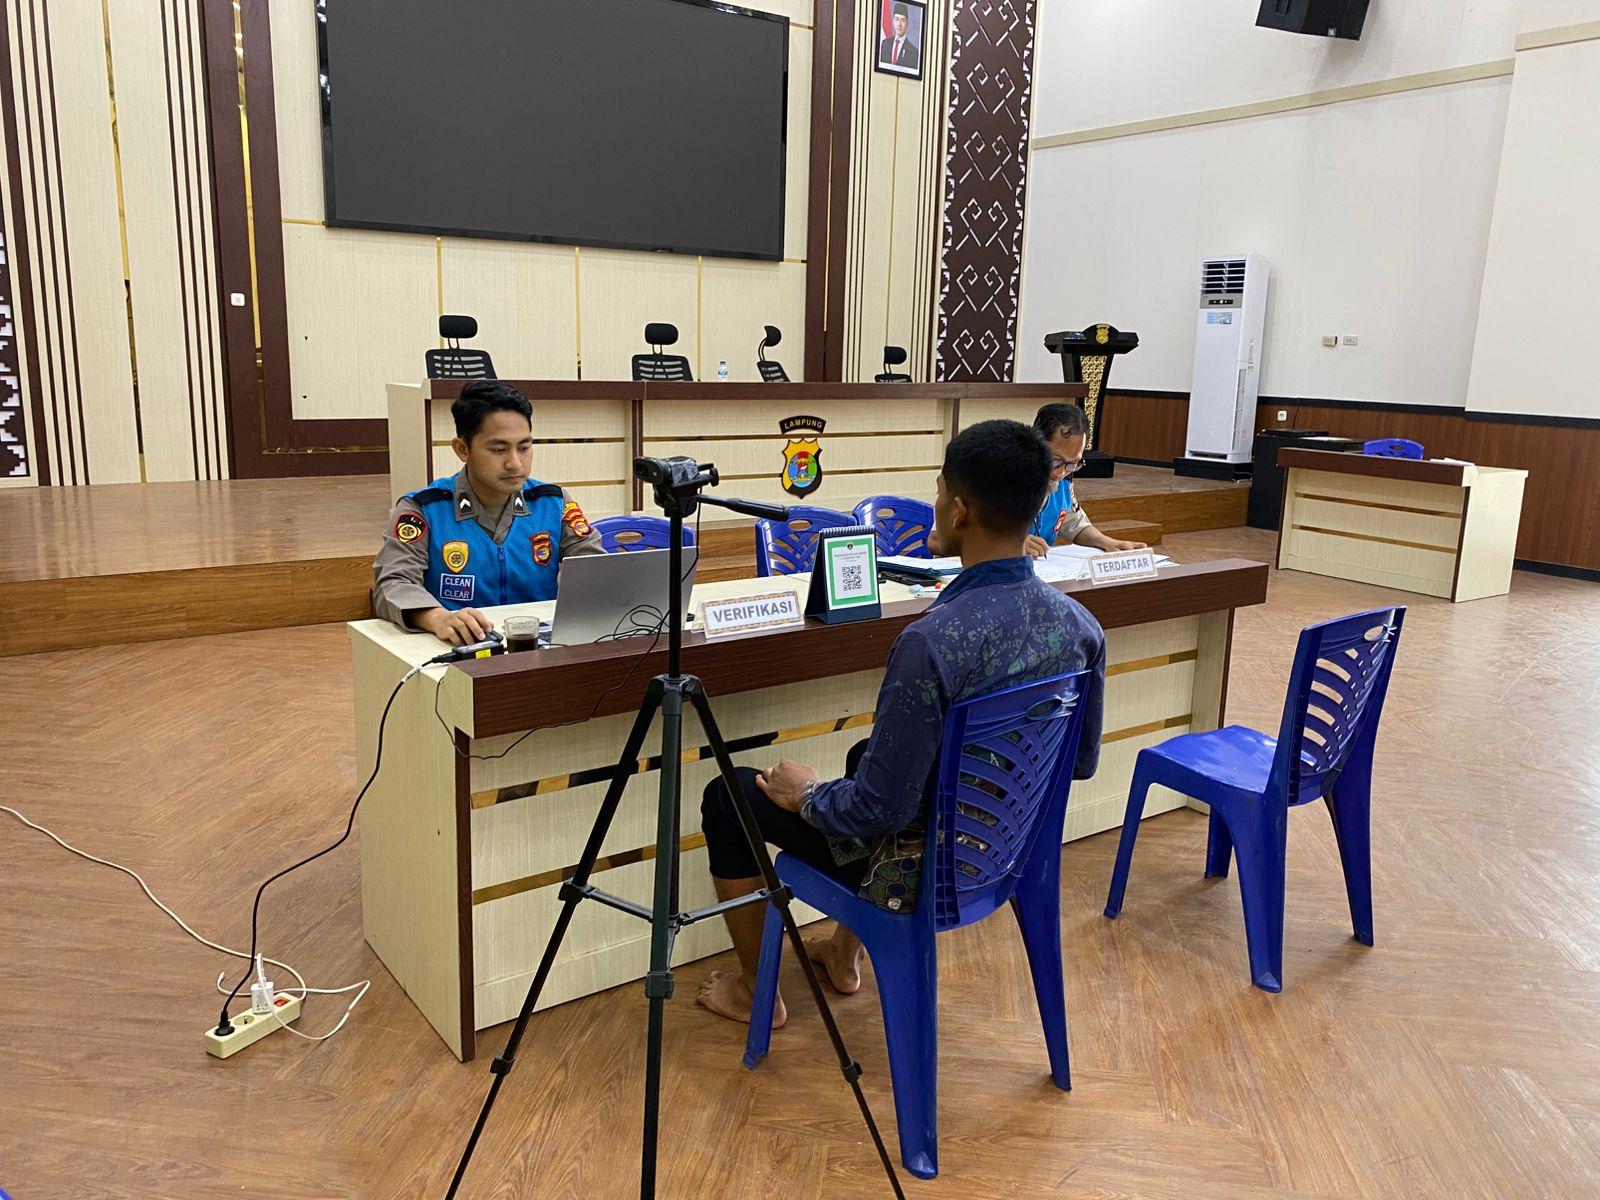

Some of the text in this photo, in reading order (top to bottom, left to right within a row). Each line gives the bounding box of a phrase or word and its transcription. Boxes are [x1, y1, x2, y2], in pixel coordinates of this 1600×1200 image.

[784, 418, 822, 429] LAMPUNG
[1097, 557, 1149, 573] TERDAFTAR
[444, 577, 471, 587] CLEAN
[444, 589, 470, 599] CLEAR
[713, 600, 792, 622] VERIFIKASI
